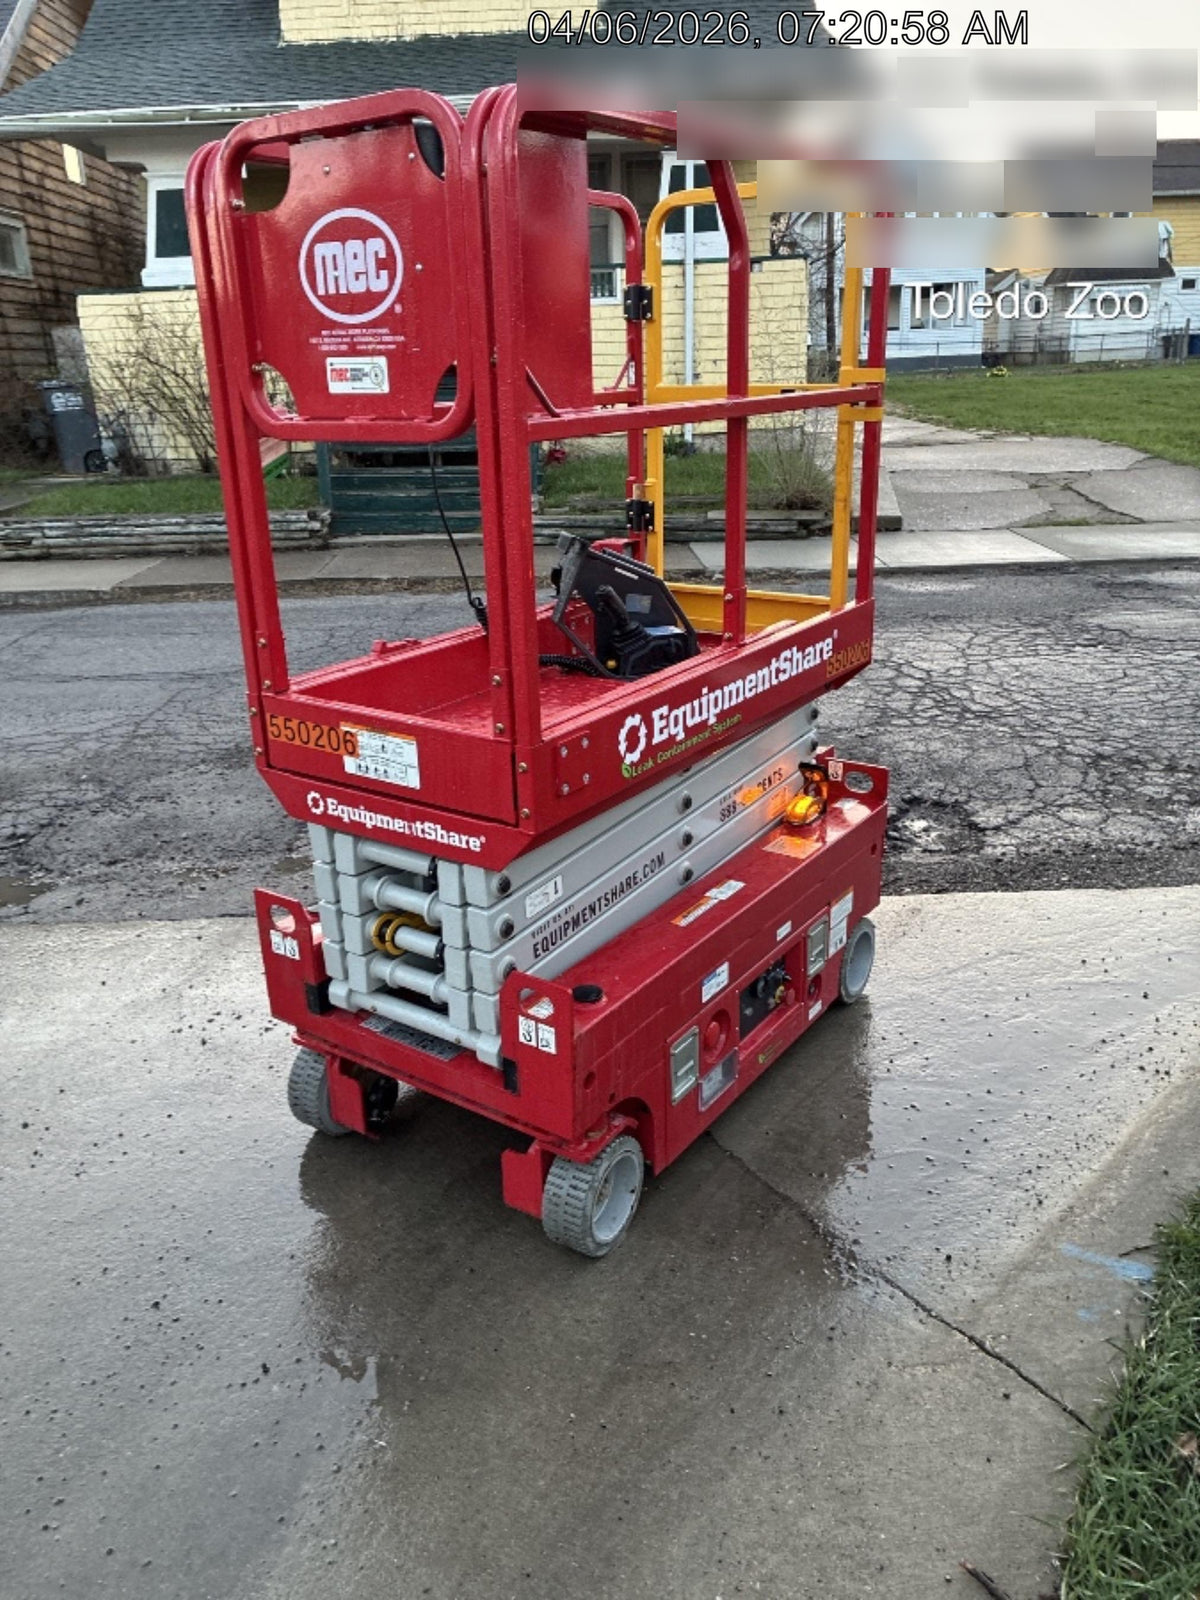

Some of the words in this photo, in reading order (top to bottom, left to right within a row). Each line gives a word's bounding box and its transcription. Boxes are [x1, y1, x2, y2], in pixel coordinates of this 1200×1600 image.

[652, 637, 834, 745] EquipmentShare
[269, 714, 357, 755] 550206
[632, 757, 655, 777] Leak
[326, 797, 482, 853] EquipmentShare
[533, 851, 666, 959] EQUIPMENTSHARE.COM
